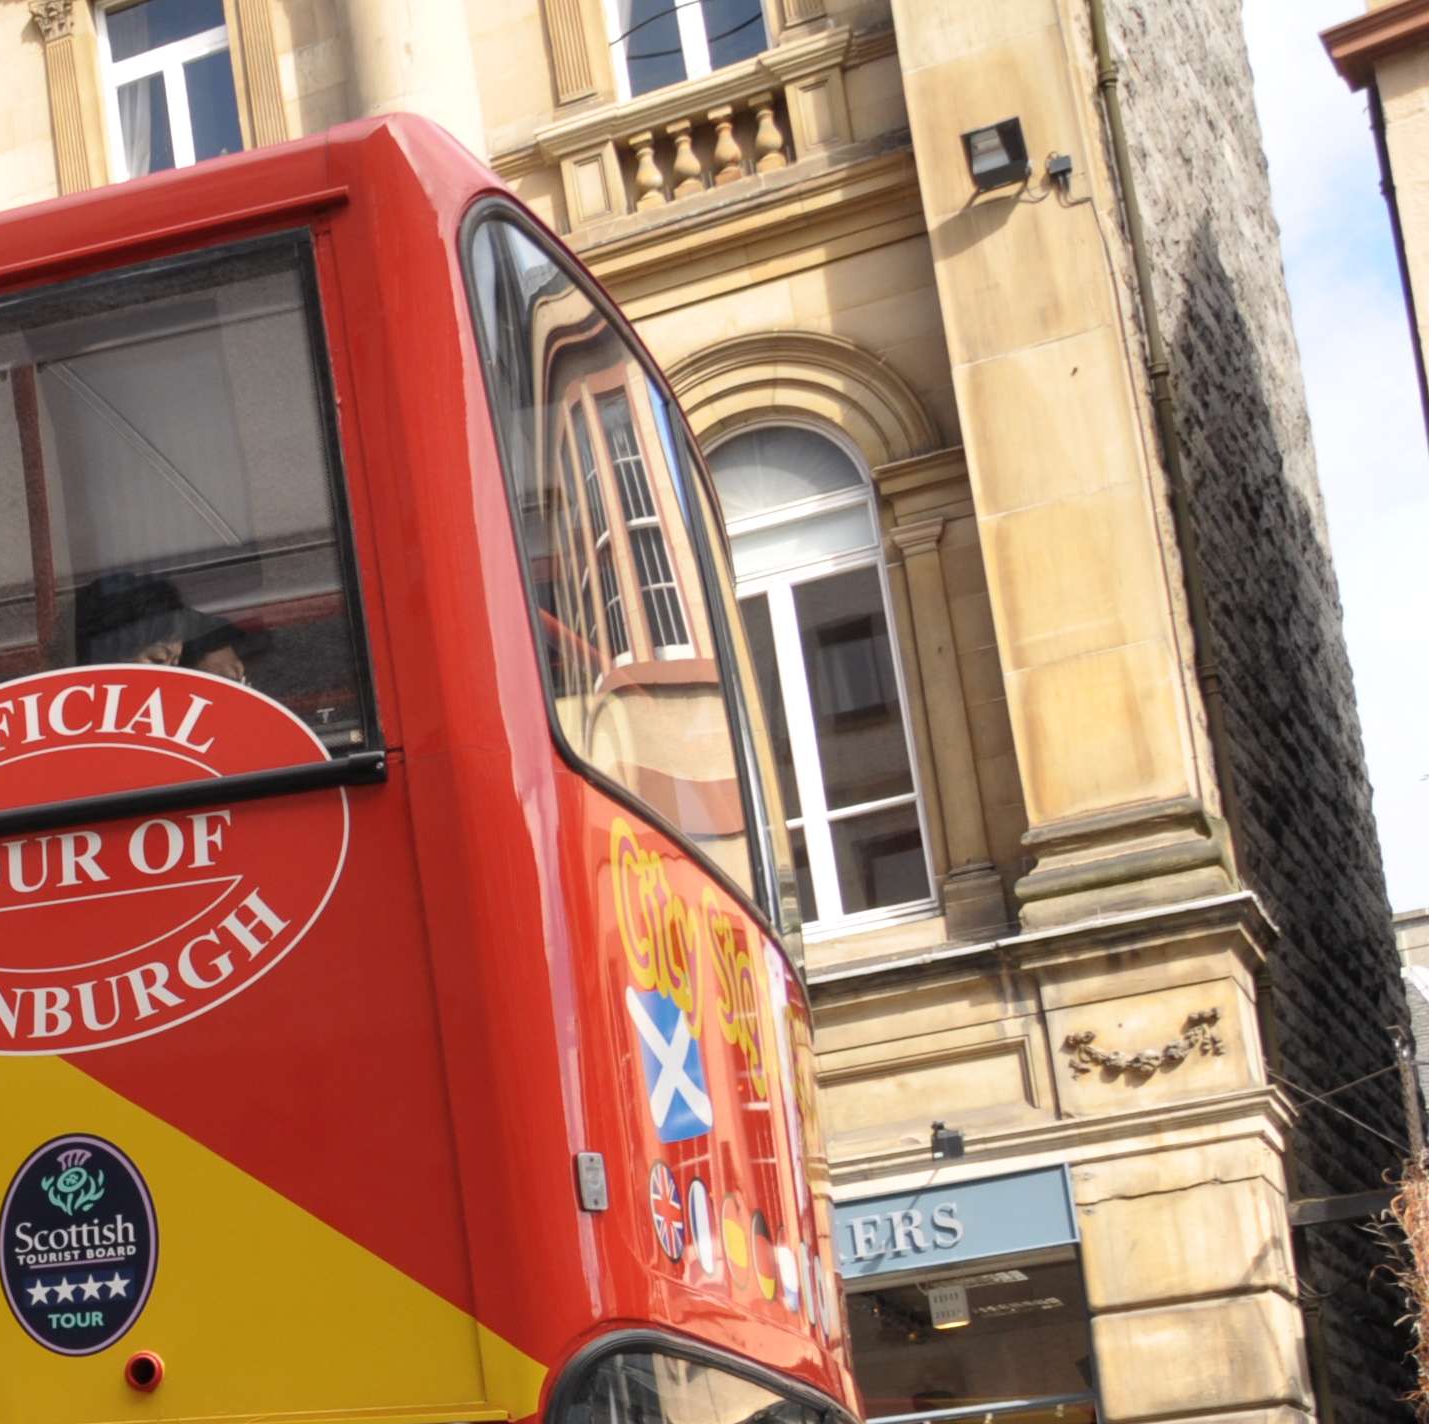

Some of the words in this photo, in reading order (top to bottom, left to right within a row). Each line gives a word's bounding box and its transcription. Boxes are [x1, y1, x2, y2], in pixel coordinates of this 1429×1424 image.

[128, 809, 233, 875] OF
[14, 1214, 136, 1253] Scottish
[839, 1201, 965, 1262] ERS
[16, 1250, 83, 1266] TOURIST
[86, 1244, 137, 1259] BOARD
[48, 1310, 105, 1329] TOUR
